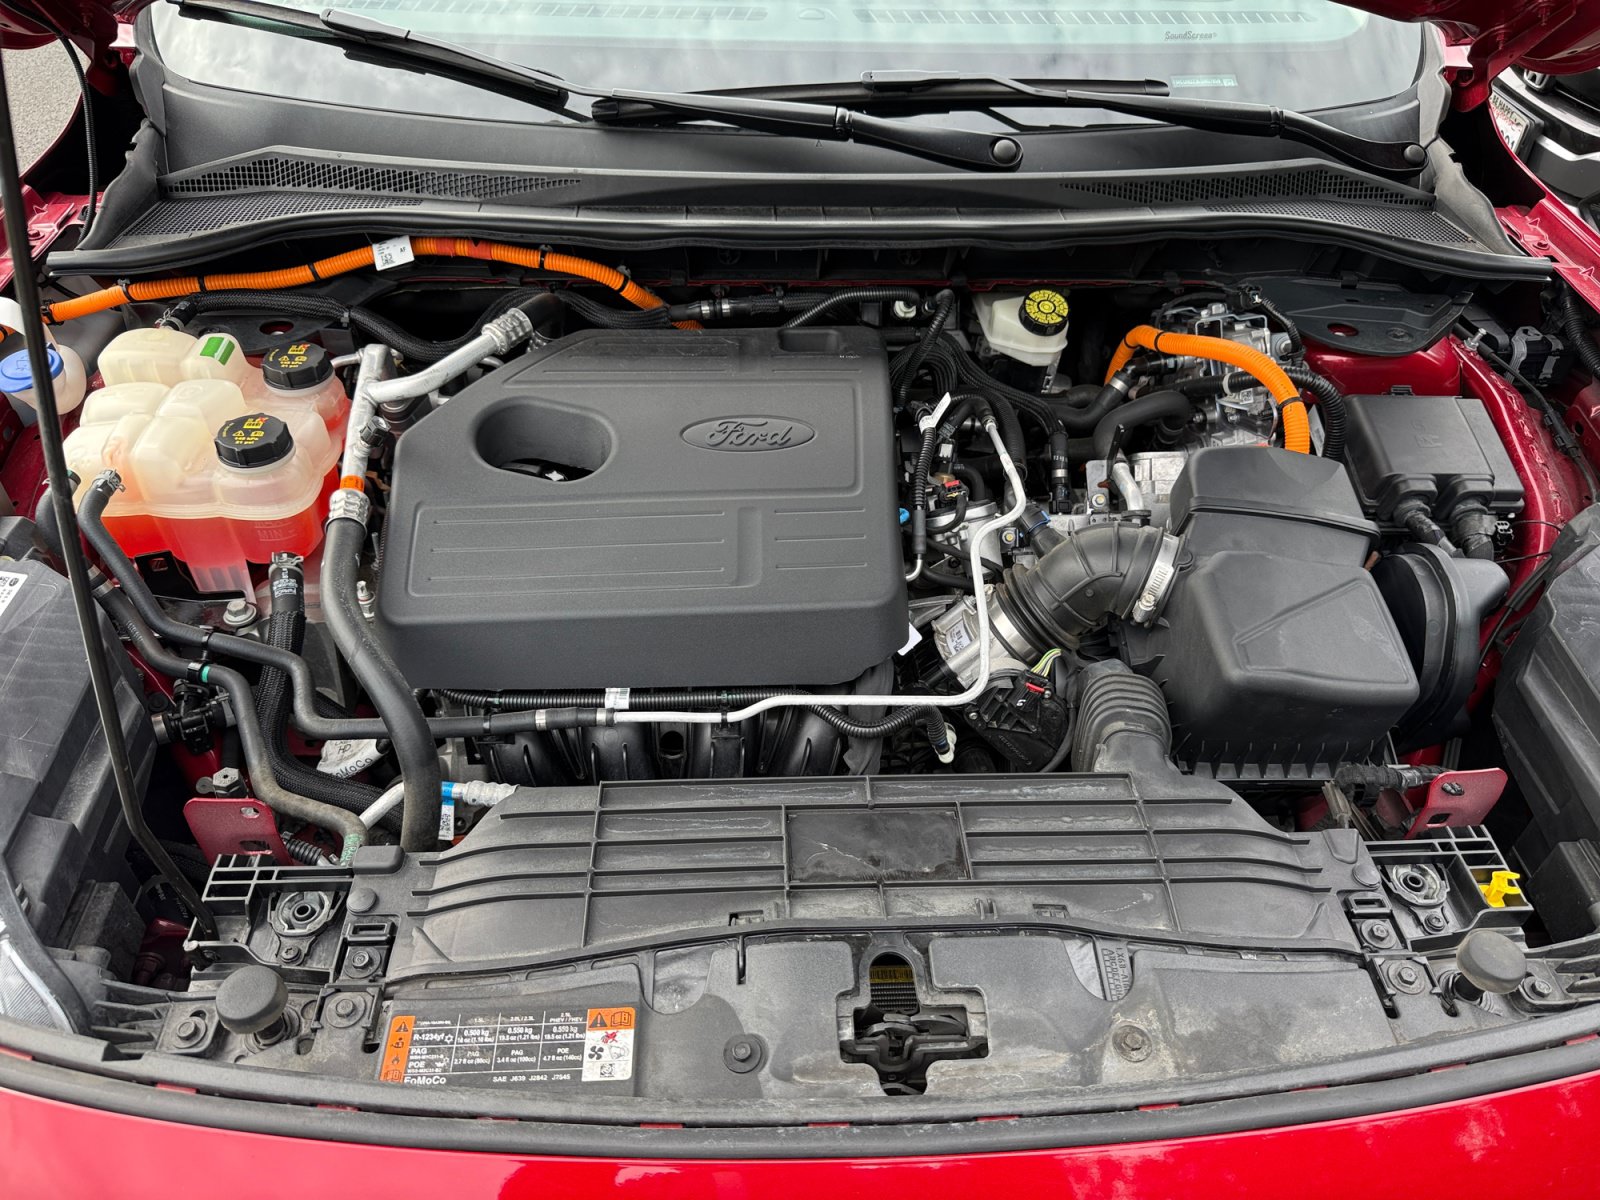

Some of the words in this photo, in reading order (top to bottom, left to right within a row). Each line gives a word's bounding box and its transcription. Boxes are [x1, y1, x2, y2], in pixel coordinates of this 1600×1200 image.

[706, 421, 793, 447] Ford
[336, 757, 374, 779] oMoCo
[480, 1029, 490, 1037] kg
[524, 1026, 533, 1034] kg
[570, 1025, 578, 1033] kg
[413, 1034, 445, 1042] R-1234yf
[404, 1076, 447, 1085] FoMoCo
